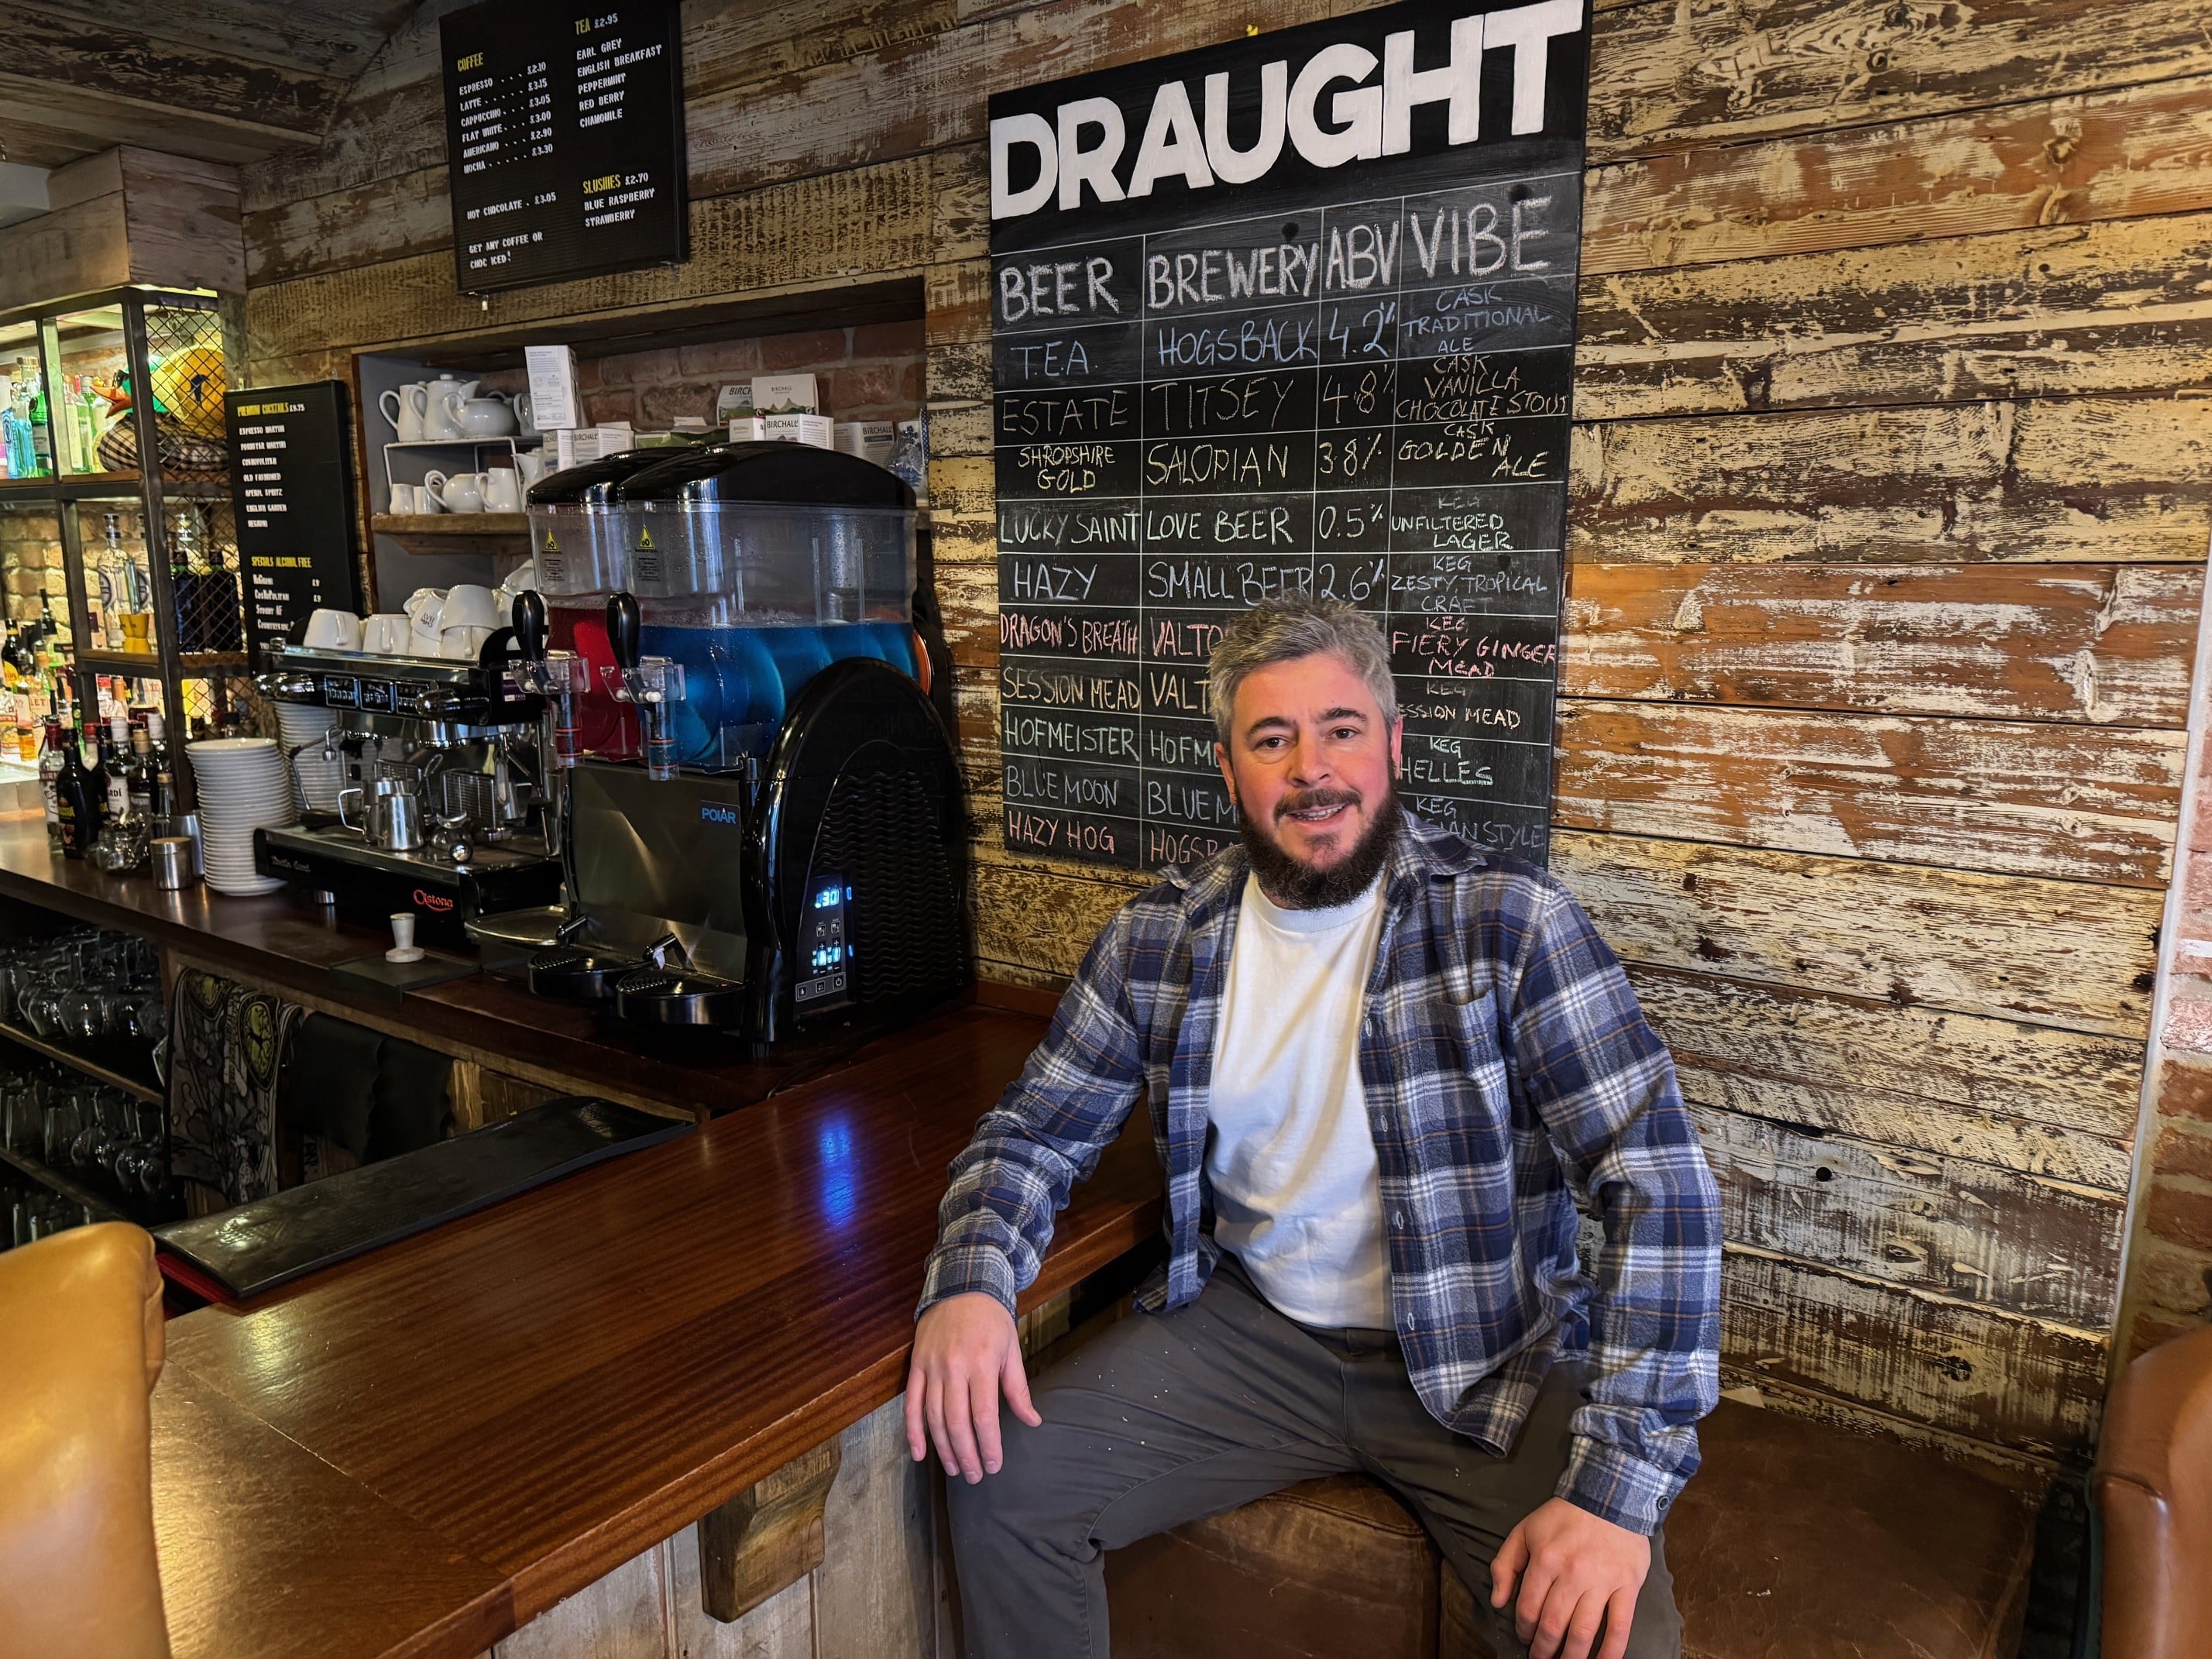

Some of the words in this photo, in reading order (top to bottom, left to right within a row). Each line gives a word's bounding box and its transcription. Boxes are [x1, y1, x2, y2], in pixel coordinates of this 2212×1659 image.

[575, 18, 591, 35] TEA
[594, 13, 618, 29] £2.95
[458, 52, 483, 72] COFFEE
[577, 46, 596, 60] EARL
[600, 38, 622, 53] GREY
[577, 59, 610, 77] ENGLISH
[614, 44, 662, 67] BREAKFAST
[459, 77, 493, 95] ESPRESSO
[527, 62, 546, 74] £2.10
[578, 73, 626, 94] PEPPERMINT
[460, 98, 482, 112] LATTE
[528, 78, 548, 91] £3.15
[461, 108, 501, 127] CAPPUCCINO
[529, 94, 551, 108] £3.05
[579, 98, 595, 112] RED
[599, 90, 624, 106] BERRY
[989, 0, 1584, 221] DRAUGHT
[462, 130, 479, 143] FLAT
[482, 124, 503, 137] WHITE
[530, 111, 551, 124] £3.00
[579, 108, 623, 128] CHAMOMILE
[463, 141, 500, 159] AMERICANO
[531, 127, 552, 140] £2.90
[463, 160, 486, 174] MOCHA
[532, 143, 553, 156] £3.30
[582, 173, 621, 194] SLUSHIES
[625, 172, 649, 186] £2.70
[467, 209, 480, 220] HOT
[483, 200, 522, 216] CHOCOLATE
[534, 192, 557, 204] £3.05
[584, 198, 604, 211] BLUE
[608, 187, 655, 207] RASPBERRY
[585, 208, 635, 228] STRAWBERRY
[469, 243, 482, 254] GET
[486, 240, 499, 251] ANY
[502, 234, 529, 247] COFFEE
[532, 232, 543, 242] OR
[1410, 195, 1552, 278] VIBE
[470, 259, 487, 270] CHOC
[490, 251, 511, 266] ICED!
[1325, 220, 1399, 290] ABV
[1000, 256, 1119, 324] BEER
[1147, 242, 1319, 309] BREWERY
[1436, 284, 1503, 312] CASK
[1400, 307, 1551, 338] TRADITIONAL
[1437, 338, 1474, 353] ALE
[1433, 355, 1491, 374] CASK
[1424, 366, 1521, 398] VANILLA
[1002, 390, 1128, 436] ESTATE
[1150, 376, 1295, 431] TITSEY
[1396, 395, 1505, 421] CHOCOLATE
[1506, 390, 1568, 415] STOUT
[767, 420, 799, 428] BIRCHALL
[1444, 421, 1495, 439] CASK
[1018, 445, 1116, 469] SHROPSHIRE
[1398, 434, 1511, 462] GOLDEN
[1146, 442, 1289, 487] SALOPIAN
[1492, 452, 1549, 478] ALE
[1037, 469, 1095, 494] GOLD
[999, 512, 1069, 547] LUCKY
[1070, 512, 1141, 544] SAINT
[1146, 512, 1202, 541] LOVE
[1214, 507, 1295, 544] BEER
[1319, 503, 1383, 540] 0.5%
[1392, 513, 1504, 532] UNFILTERED
[1433, 532, 1513, 551] LAGER
[1433, 555, 1472, 573] KEG
[1014, 561, 1098, 601] HAZY
[1148, 560, 1235, 599] SMALL
[1237, 562, 1312, 606] BEER
[1319, 558, 1384, 602] 2.6%
[1461, 572, 1547, 592] TROPICAL
[1422, 596, 1493, 613] CRAFT
[1000, 613, 1077, 650] DRAGON'S
[1082, 620, 1138, 656] BREATH
[1150, 617, 1224, 657] VALTO
[1426, 616, 1468, 632] KEG
[1393, 630, 1470, 658] FIERY
[1477, 636, 1556, 665] GINGER
[1429, 657, 1495, 678] MEAD
[1002, 667, 1084, 706] SESSION
[1091, 678, 1139, 711] MEAD
[1150, 672, 1211, 715] VALT
[1427, 682, 1465, 696] KEG
[1396, 703, 1456, 721] ESSION
[1465, 708, 1520, 730] MEAD
[1004, 710, 1139, 762] HOFMEISTER
[1150, 729, 1220, 768] HOFM
[1430, 736, 1462, 758] KEG
[1400, 756, 1494, 786] HELLES
[1006, 765, 1059, 800] BLUE
[1064, 775, 1118, 809] MOON
[1148, 781, 1211, 821] BLUE
[702, 808, 737, 824] POLAR
[1417, 796, 1456, 819] KEG
[1008, 809, 1057, 847] HAZY
[1067, 820, 1115, 854] HOG
[1483, 820, 1547, 852] STYLE
